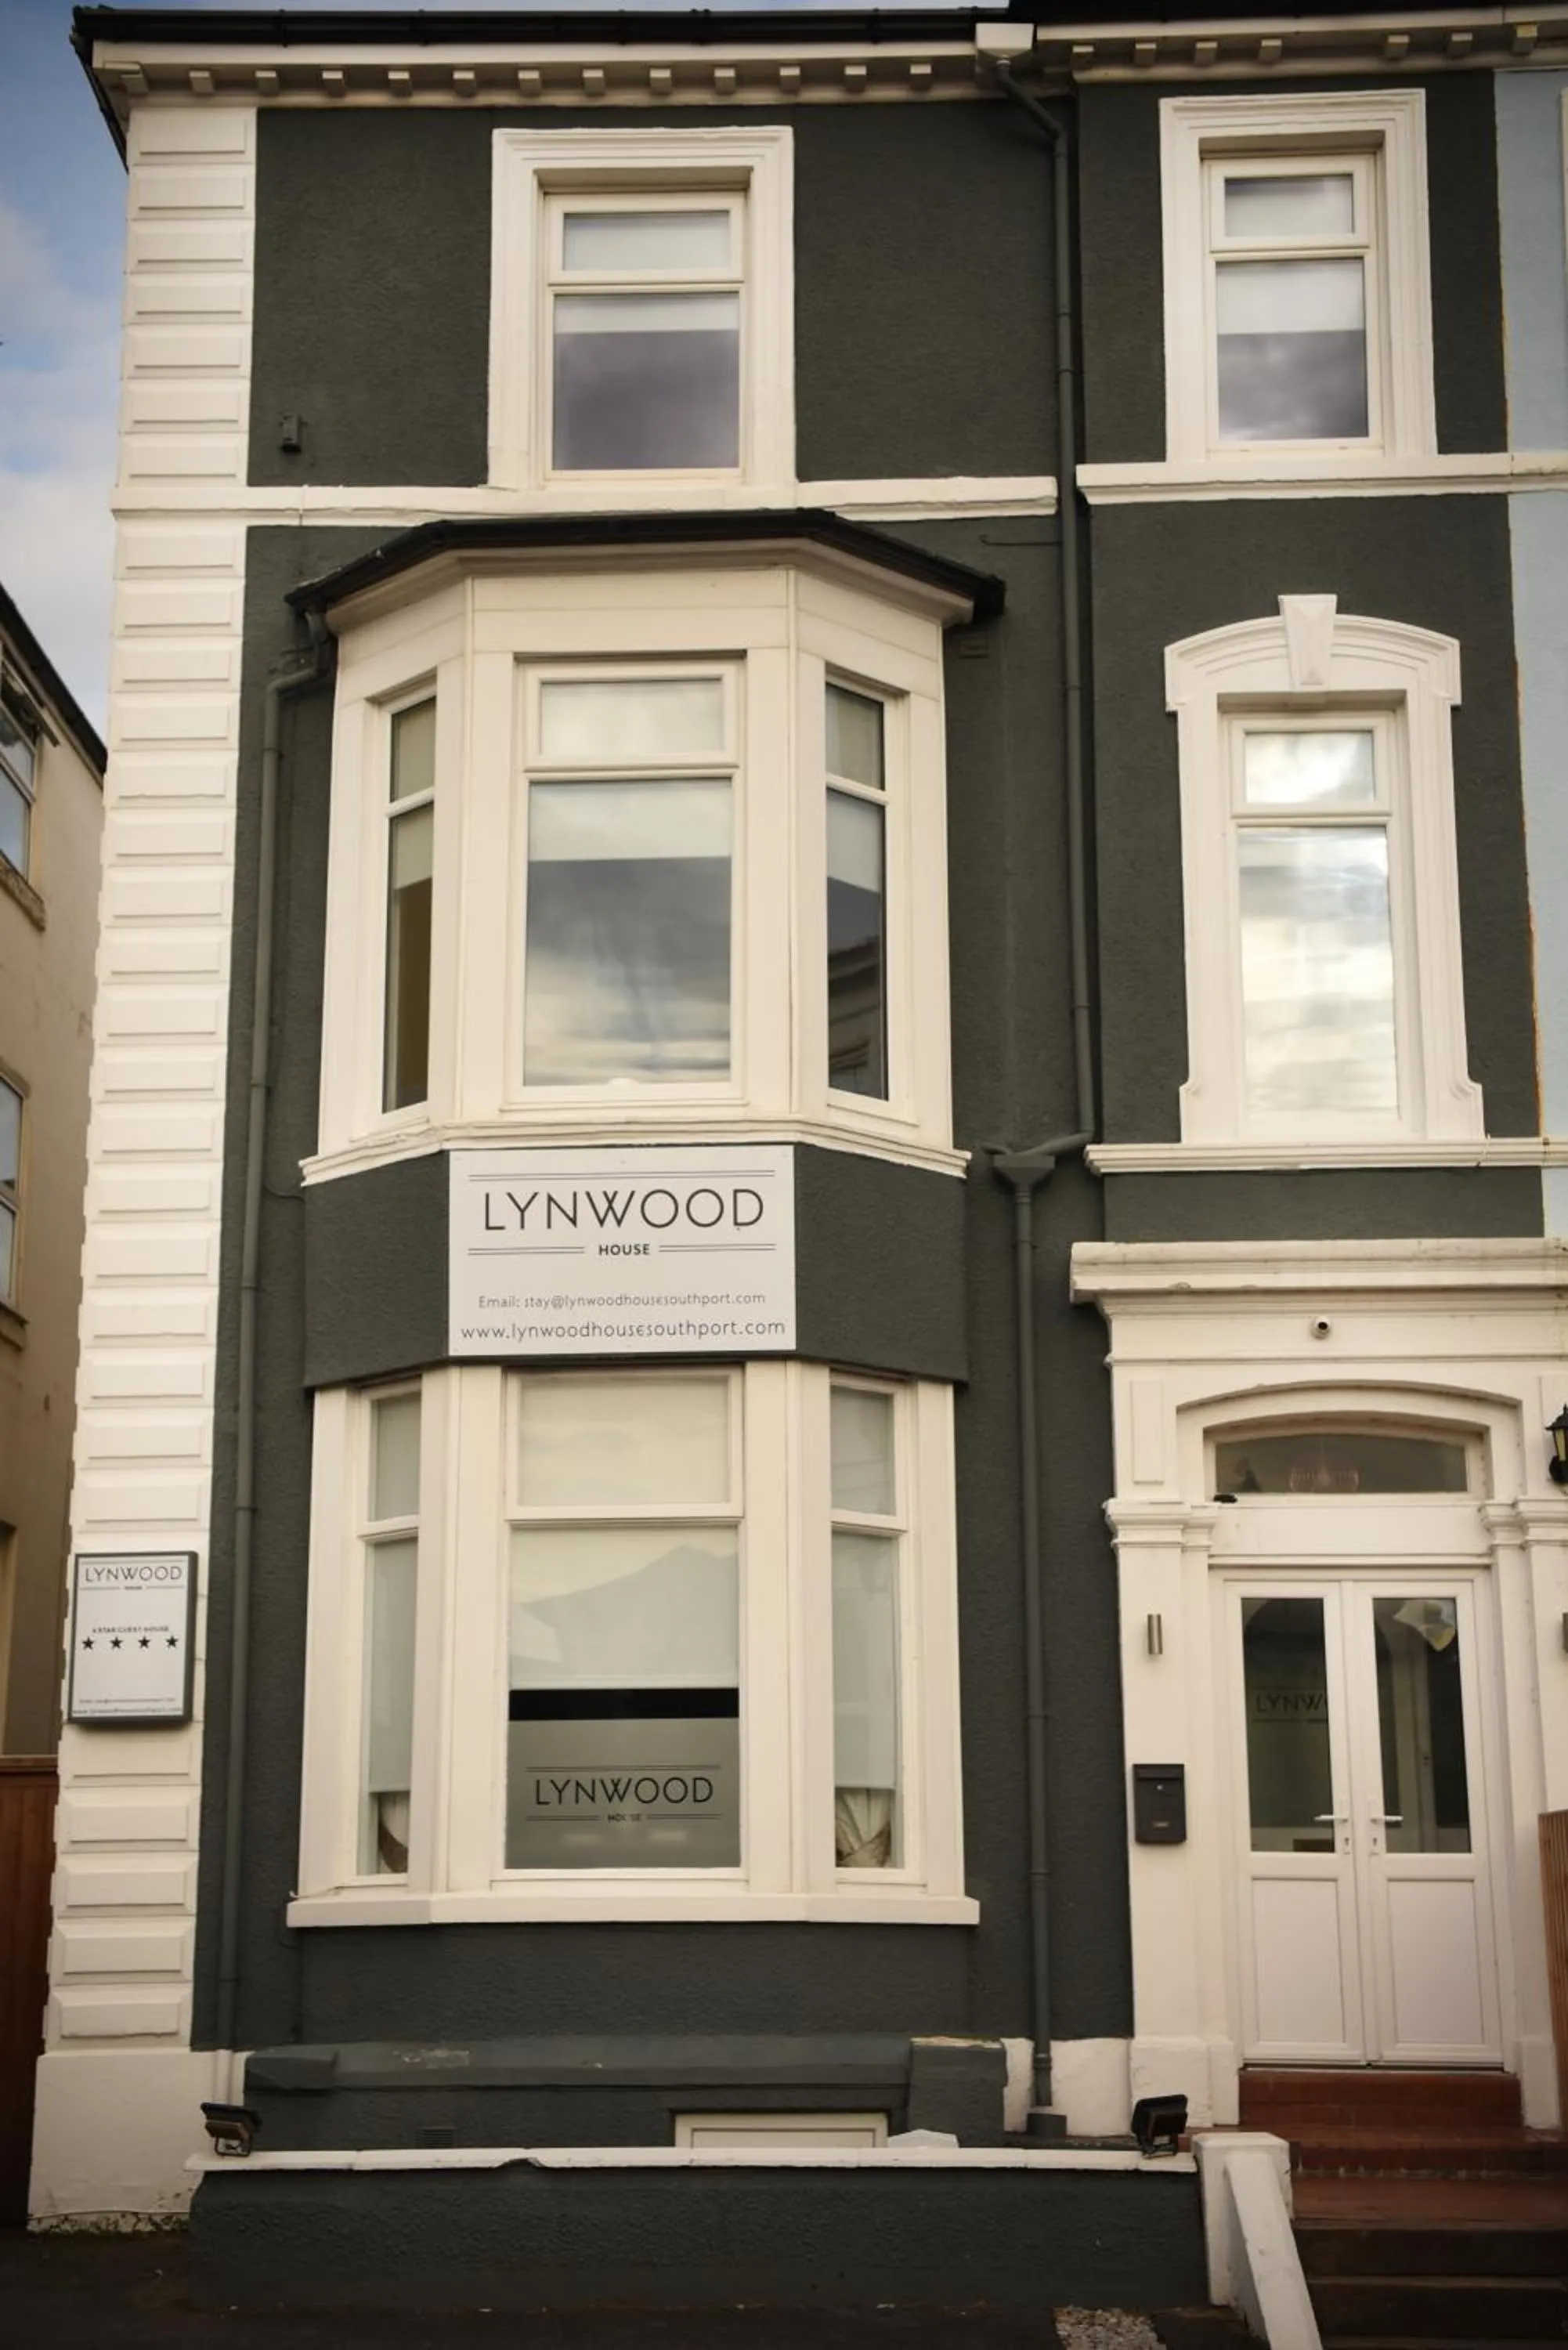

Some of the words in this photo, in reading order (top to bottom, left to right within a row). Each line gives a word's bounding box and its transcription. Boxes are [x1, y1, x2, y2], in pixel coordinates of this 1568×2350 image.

[485, 1188, 764, 1231] LYNWOOD
[598, 1243, 651, 1256] HOUSE
[478, 1295, 521, 1309] Email:
[524, 1292, 766, 1311] stay@lynwoodhousesouthport.com
[461, 1320, 786, 1343] www.lynwoodhousesouthport.com
[85, 1566, 182, 1582] LYNWOOD
[1256, 1692, 1327, 1713] LYNW
[535, 1777, 714, 1806] LYNWOOD
